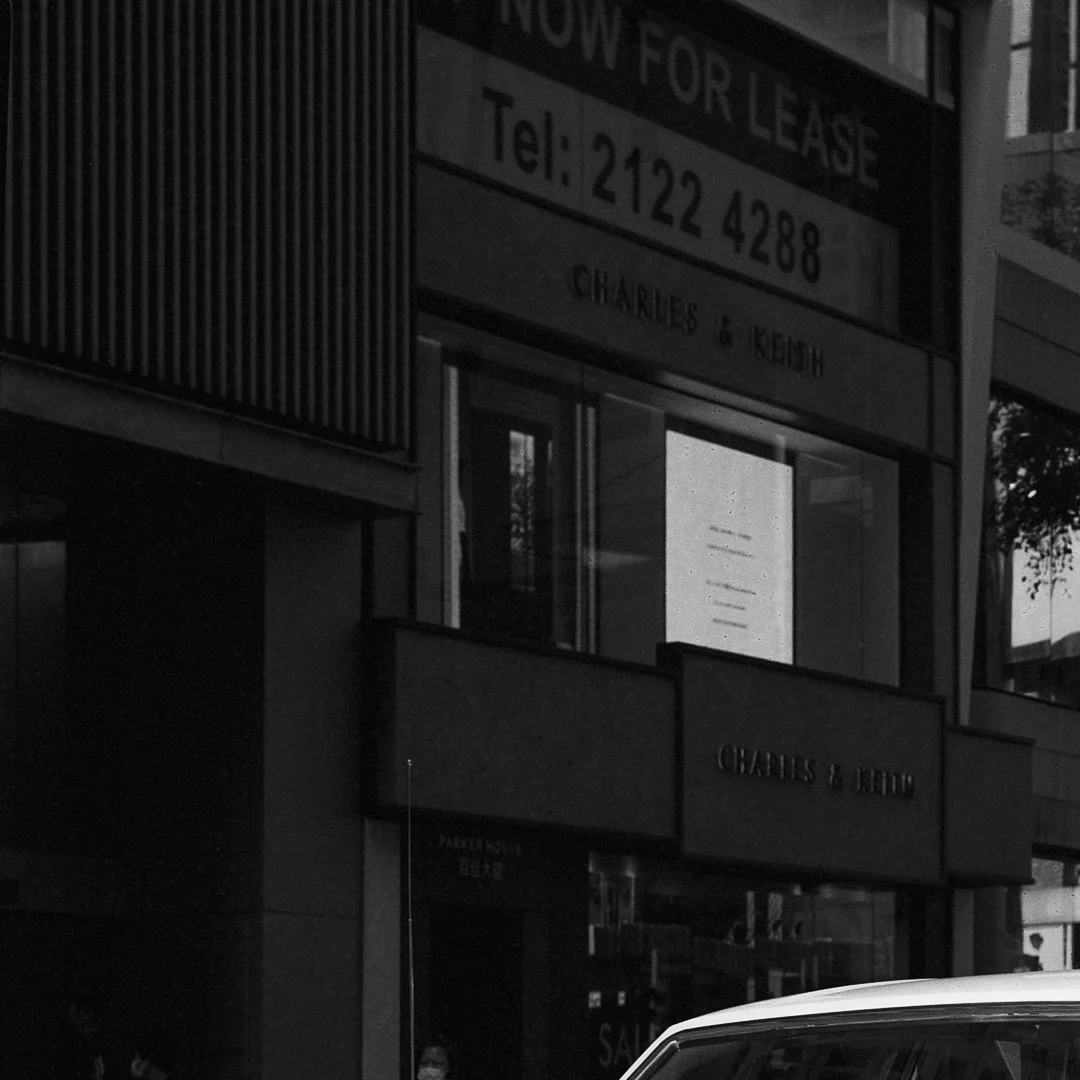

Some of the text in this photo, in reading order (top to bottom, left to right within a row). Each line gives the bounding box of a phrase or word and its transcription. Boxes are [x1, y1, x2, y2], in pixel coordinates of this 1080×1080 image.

[638, 20, 734, 124] FOR
[748, 72, 881, 190] LEASE
[482, 86, 822, 284] Tel: 2122 4288
[568, 264, 825, 377] CHARLES & KEITH
[716, 743, 916, 799] CHARLES & KEITH
